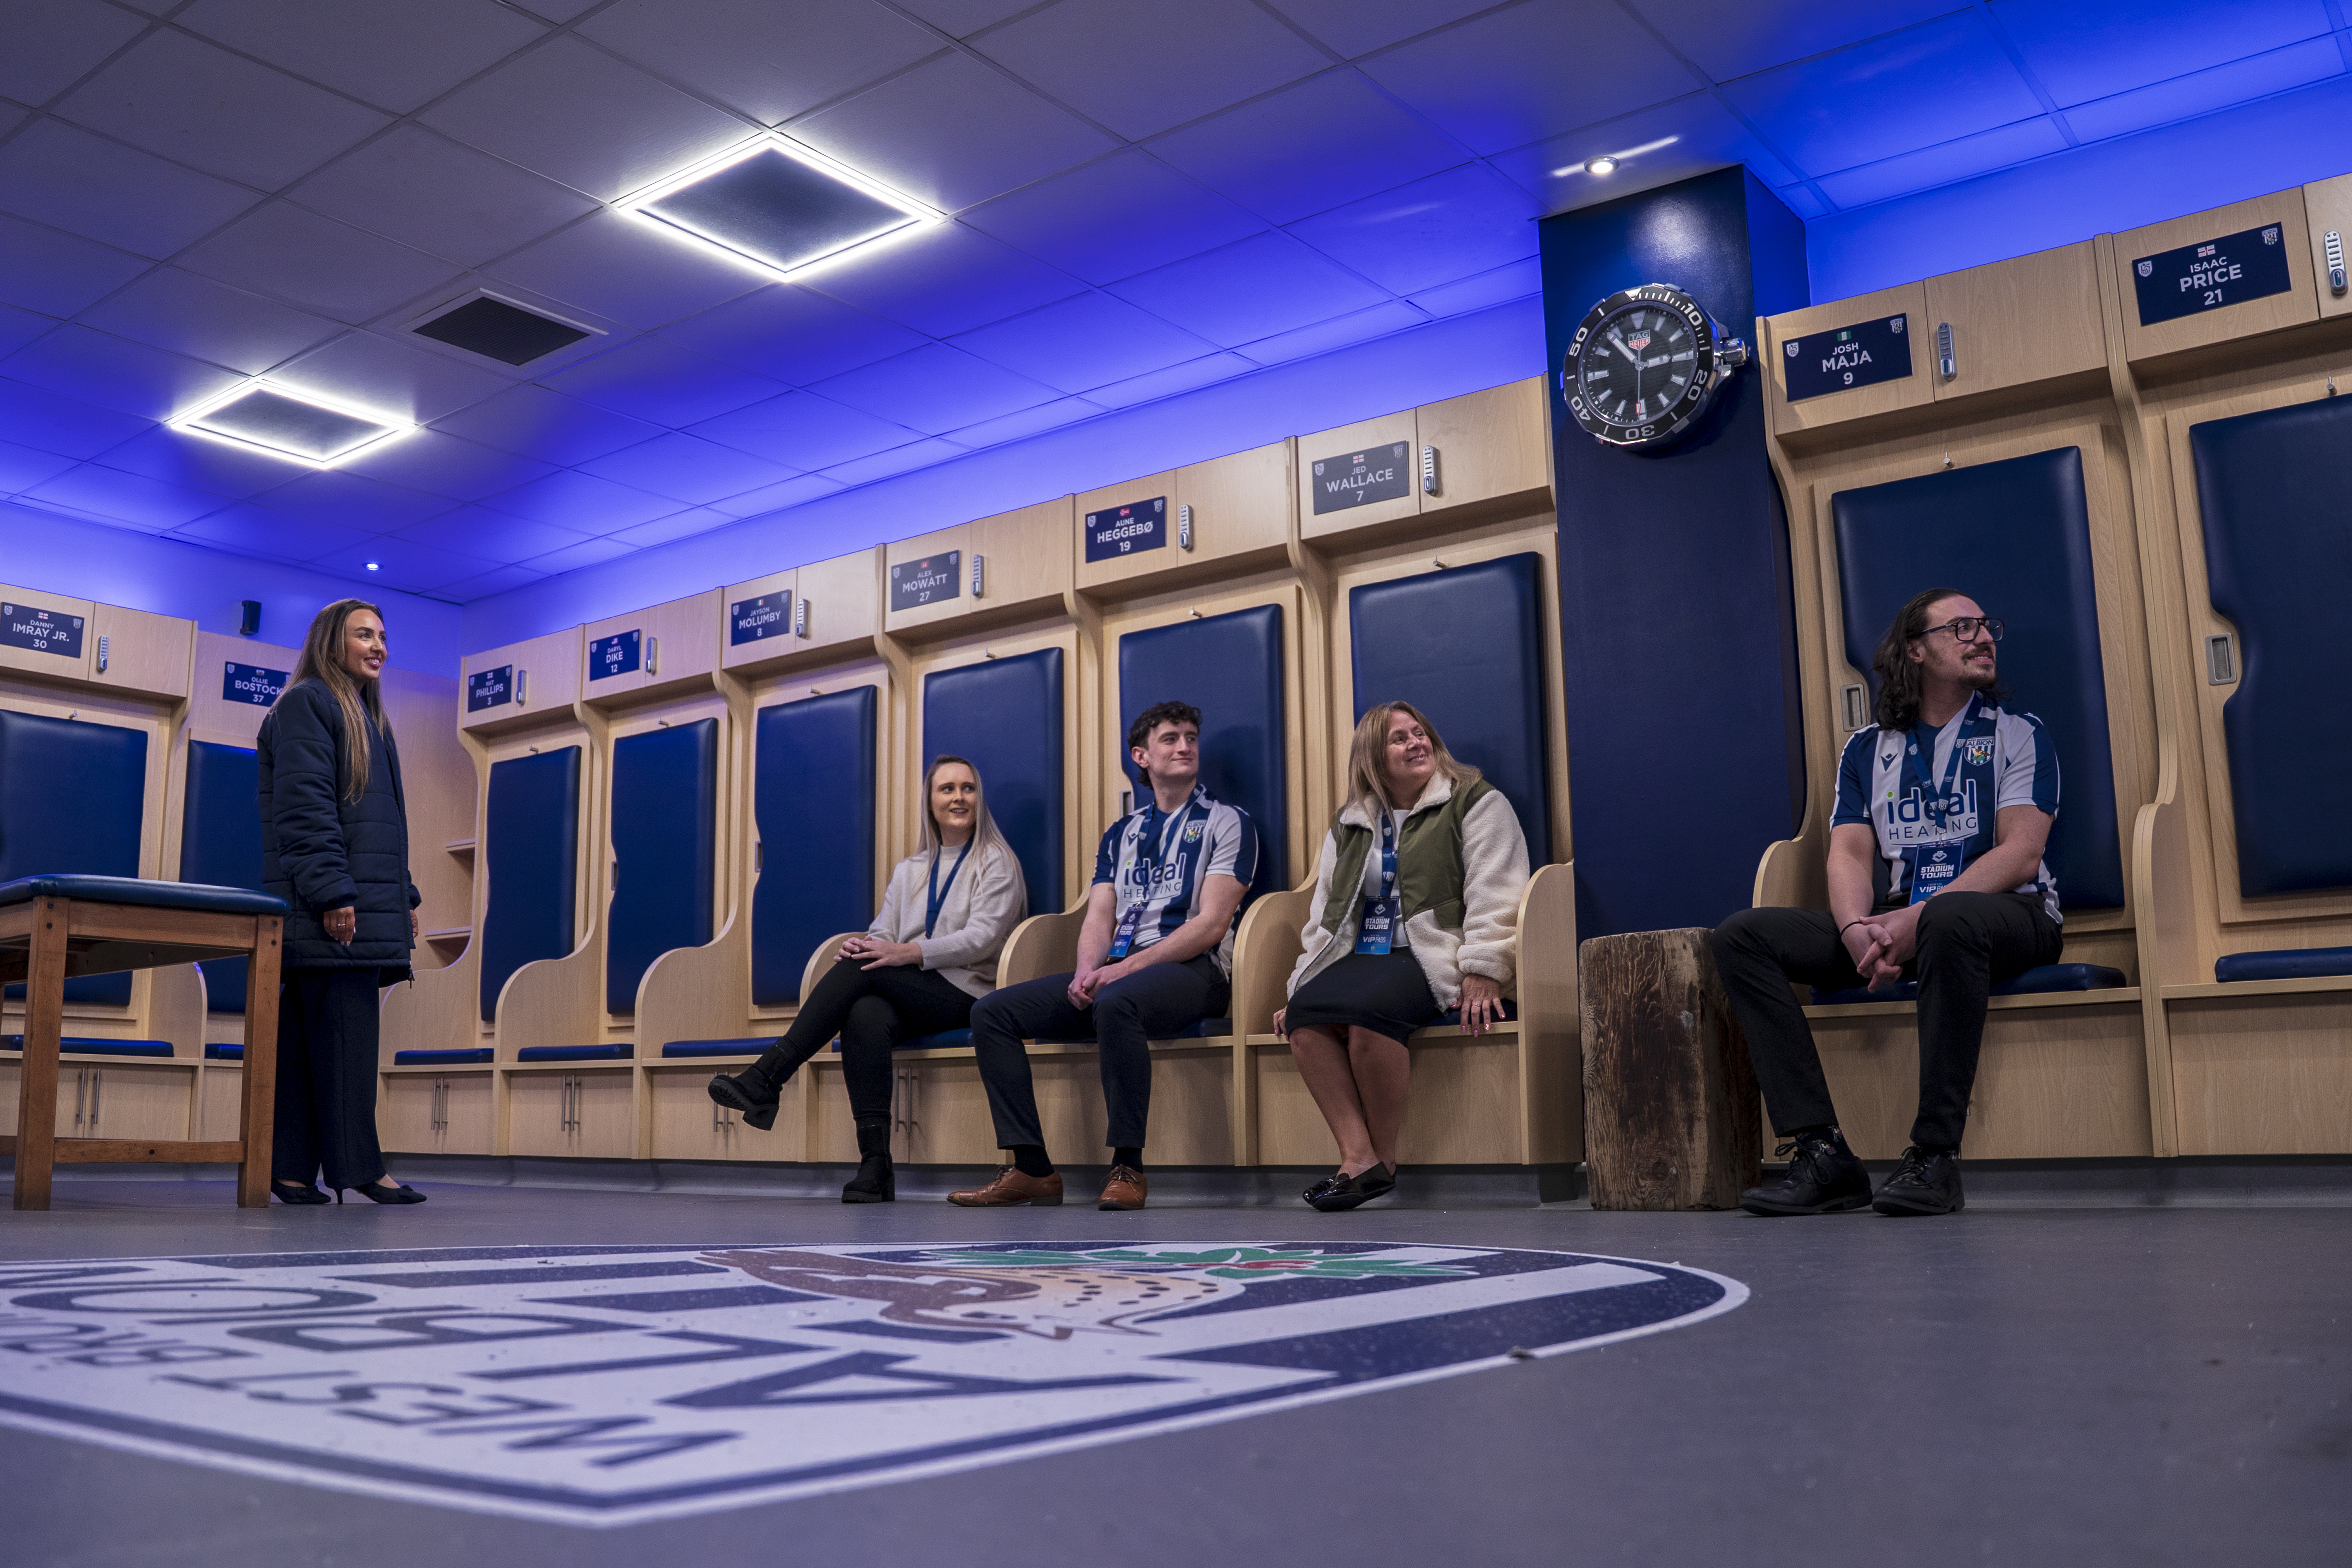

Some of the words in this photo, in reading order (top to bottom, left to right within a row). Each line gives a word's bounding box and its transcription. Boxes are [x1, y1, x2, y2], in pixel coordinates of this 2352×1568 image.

[2190, 257, 2227, 273] ISAAC
[2180, 264, 2242, 292] PRICE
[2204, 289, 2222, 305] 21
[1684, 303, 1703, 326] 10
[1569, 327, 1588, 356] 50
[1630, 331, 1648, 340] TAG
[1832, 342, 1859, 355] JOSH
[1822, 350, 1872, 373] MAJA
[1688, 369, 1707, 400] 20
[1843, 372, 1853, 385] 9
[1571, 396, 1591, 421] 40
[1625, 425, 1655, 439] 30
[1352, 466, 1366, 475] JED
[1326, 468, 1393, 492] WALLACE
[1357, 491, 1363, 501] 7
[1116, 517, 1134, 527] AUNE
[1097, 521, 1153, 543] HEGGEBØ
[1119, 541, 1131, 552] 19
[917, 570, 932, 579] ALEX
[903, 574, 947, 593] MOWATT
[919, 591, 930, 602] 27
[750, 607, 770, 616] JAYSON
[30, 620, 54, 629] DANNY
[739, 611, 781, 629] MOLUMBY
[13, 623, 50, 637] IMRAY
[52, 631, 69, 641] JR.
[757, 628, 762, 637] 8
[33, 639, 47, 648] 30
[607, 645, 622, 653] DARYL
[606, 651, 623, 664] DIKE
[611, 664, 618, 673] 12
[235, 680, 283, 695] BOSTOCK
[476, 683, 503, 698] PHILLIPS
[253, 694, 264, 702] 37
[1124, 854, 1185, 885] ideal
[1921, 864, 1954, 873] STADIUM
